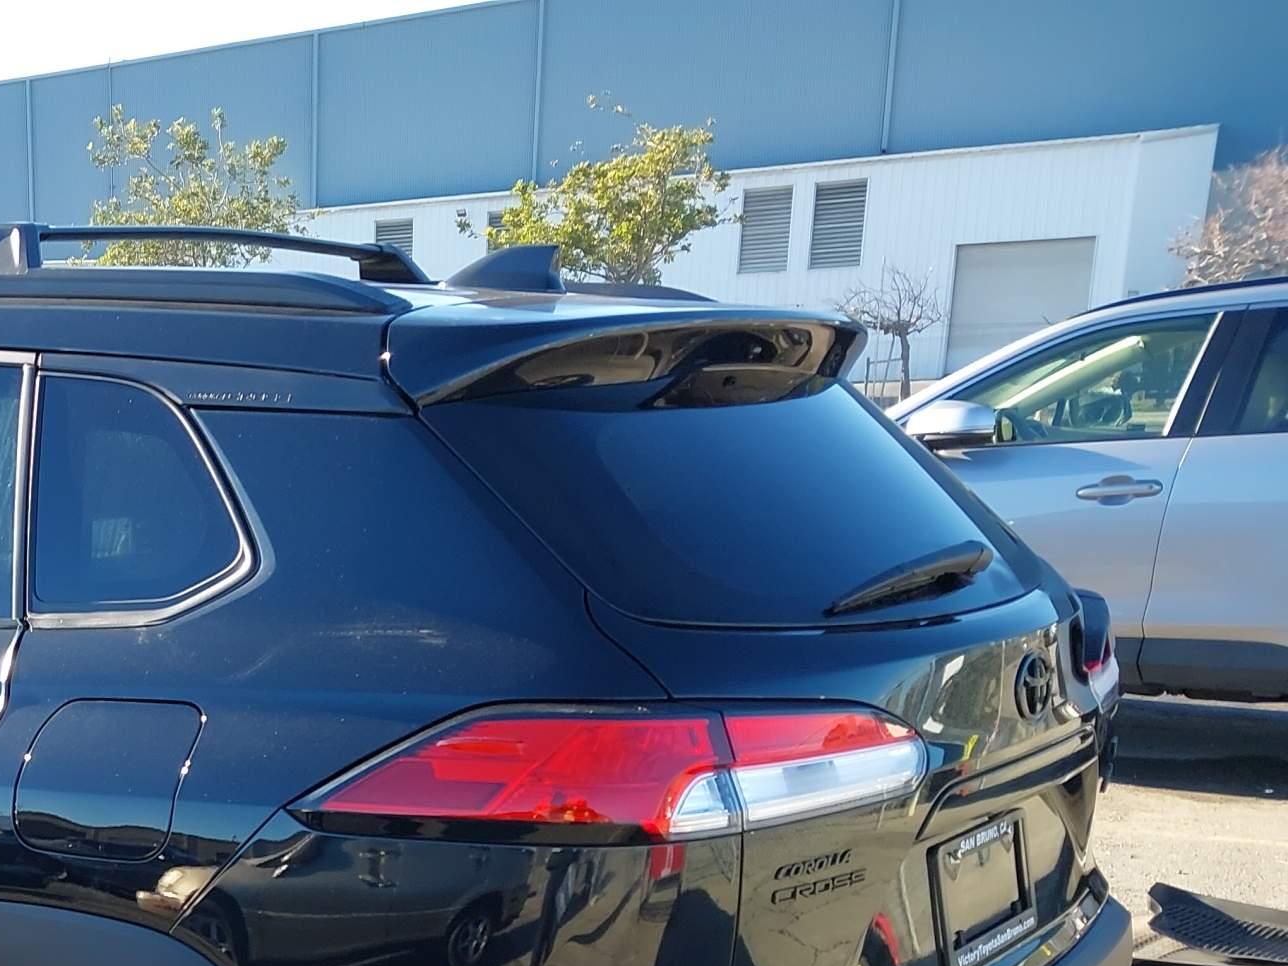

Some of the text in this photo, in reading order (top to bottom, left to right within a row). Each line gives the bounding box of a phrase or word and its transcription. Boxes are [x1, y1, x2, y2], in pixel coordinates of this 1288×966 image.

[960, 835, 976, 852] SAN
[774, 848, 852, 880] COROLLA
[771, 868, 867, 905] CROSS
